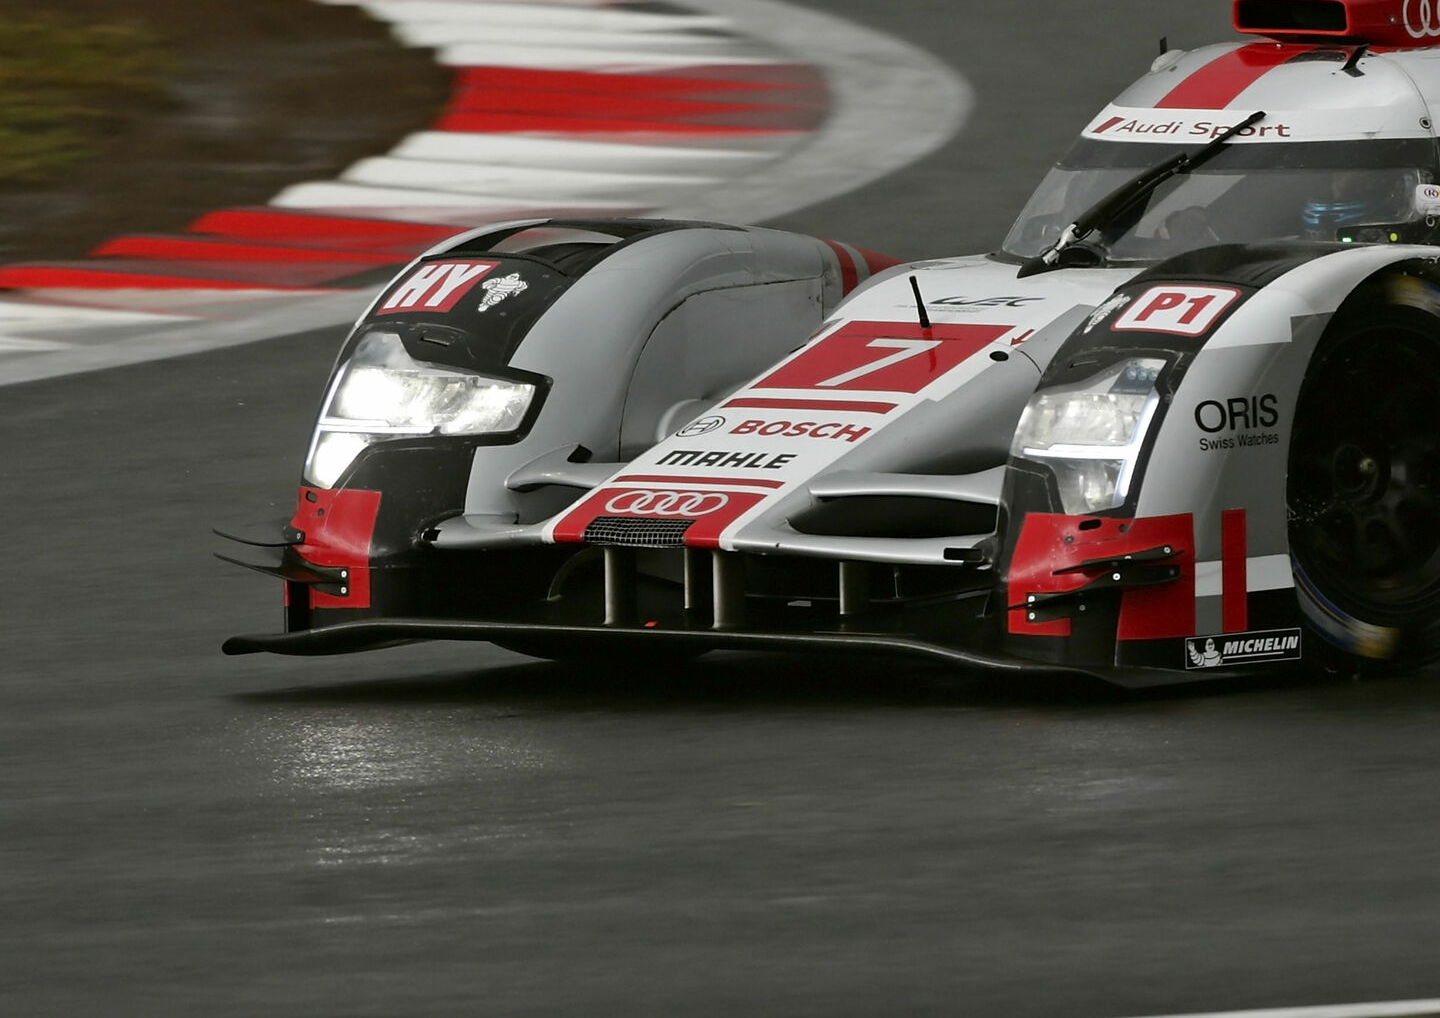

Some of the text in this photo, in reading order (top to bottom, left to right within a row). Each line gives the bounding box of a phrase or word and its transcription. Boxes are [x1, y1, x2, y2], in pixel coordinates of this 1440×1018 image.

[1116, 119, 1291, 139] Audi Sport
[382, 263, 492, 310] HY
[1134, 292, 1214, 325] P1
[815, 337, 943, 387] 7
[1194, 393, 1279, 433] ORIS
[728, 419, 873, 443] BOSCH
[1200, 433, 1280, 451] Swiss Watches
[655, 449, 798, 470] MAHLE
[1223, 635, 1299, 655] MICHELIN
